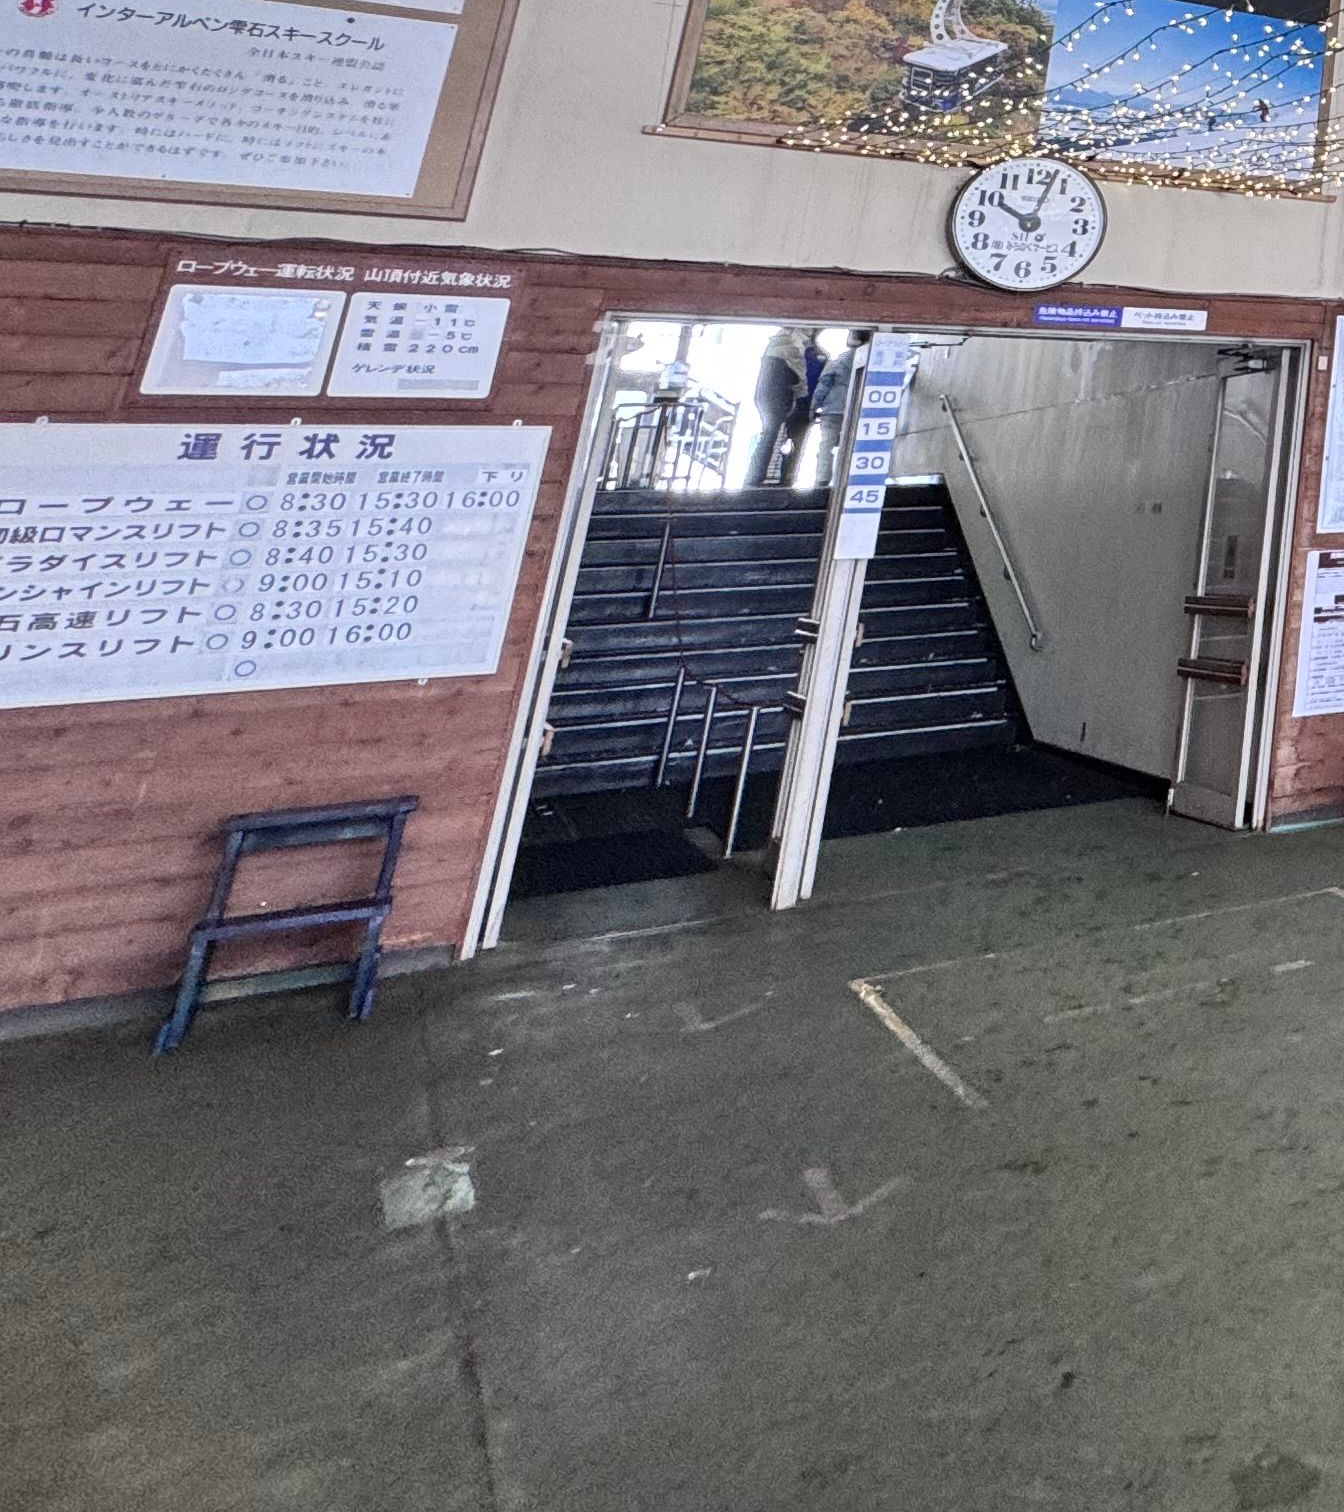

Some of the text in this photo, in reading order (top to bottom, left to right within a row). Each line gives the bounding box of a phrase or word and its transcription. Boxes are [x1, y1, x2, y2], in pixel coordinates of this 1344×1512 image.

[1000, 172, 1020, 190] 11
[1026, 168, 1051, 185] 12
[1059, 178, 1068, 195] 1
[978, 189, 1005, 207] 10
[1069, 196, 1086, 213] 2
[968, 210, 986, 228] 9
[1072, 218, 1089, 236] 3
[971, 232, 990, 251] 8
[1060, 240, 1077, 258] 4
[989, 253, 1008, 272] 7
[1014, 261, 1032, 279] 6
[1040, 255, 1057, 274] 5
[176, 260, 512, 288] ロープウェー運転状況 山頂付近気象状況
[352, 363, 436, 374] ゲレンデ状況
[868, 391, 896, 403] 00
[863, 423, 890, 436] 15
[177, 432, 396, 461] 運行状況
[855, 457, 885, 470] 30
[0, 490, 520, 516] ロープウェー 8:30 15:30 16:00
[849, 491, 880, 504] 45
[272, 519, 342, 538] 8:35
[352, 517, 432, 537] 15:40
[0, 542, 428, 573] ラダイスリフト 8:40 15:30
[259, 573, 328, 593] 9:00
[339, 568, 423, 589] 15:10
[250, 600, 322, 621] 8:30
[334, 595, 419, 616] 15:20
[241, 627, 316, 650] 9:00
[328, 622, 413, 642] 16:00
